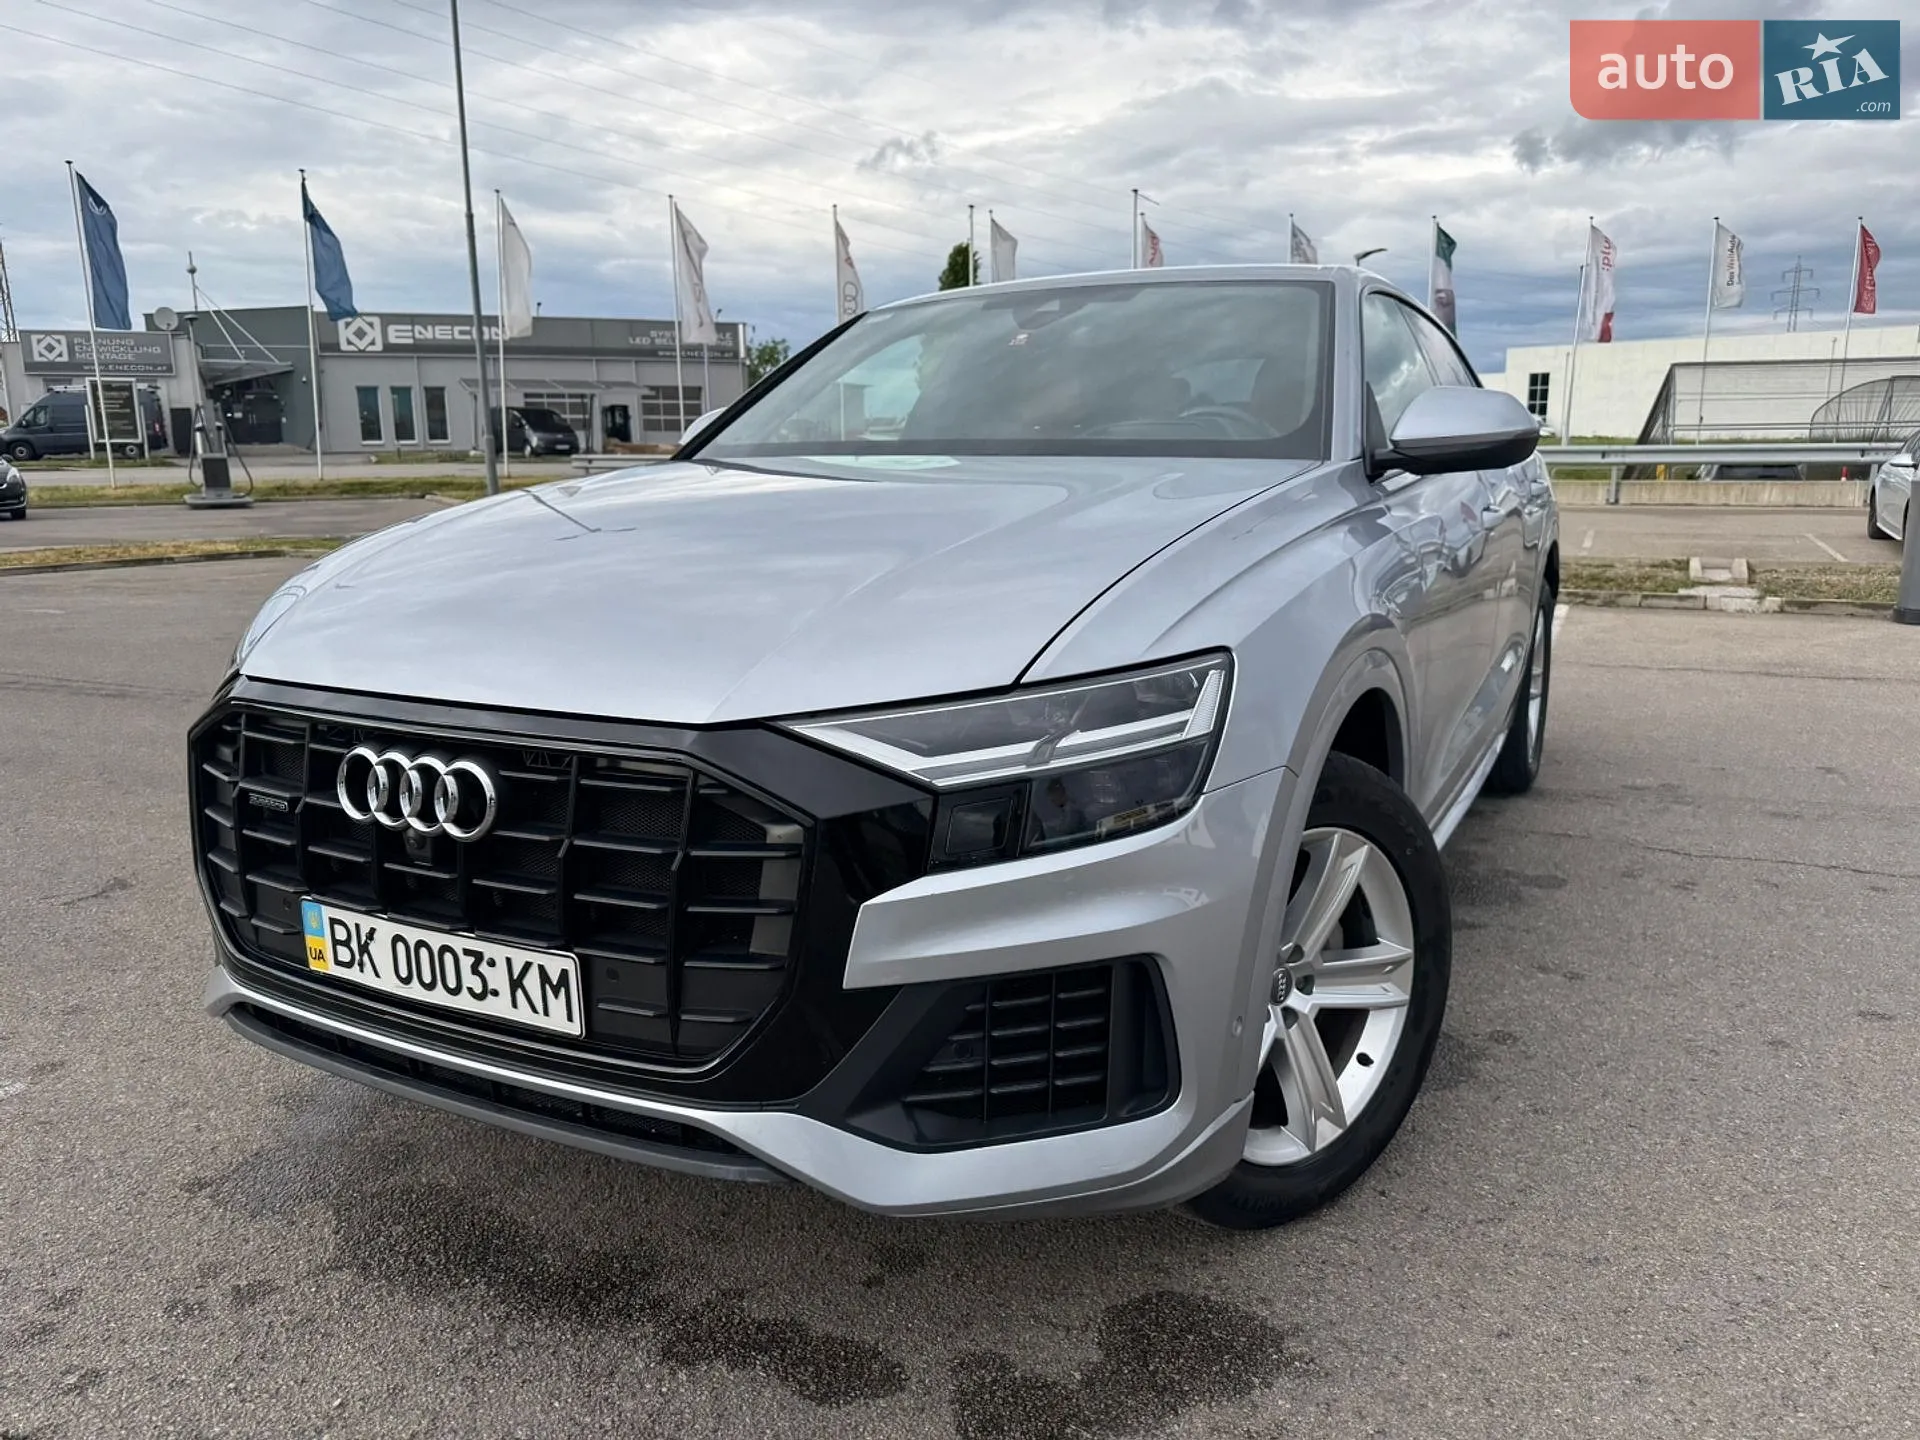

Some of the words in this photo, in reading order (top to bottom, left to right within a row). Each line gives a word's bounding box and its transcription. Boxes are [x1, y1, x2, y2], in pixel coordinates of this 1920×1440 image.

[309, 946, 326, 962] UA
[391, 933, 489, 1001] 0003
[505, 956, 574, 1023] KM
